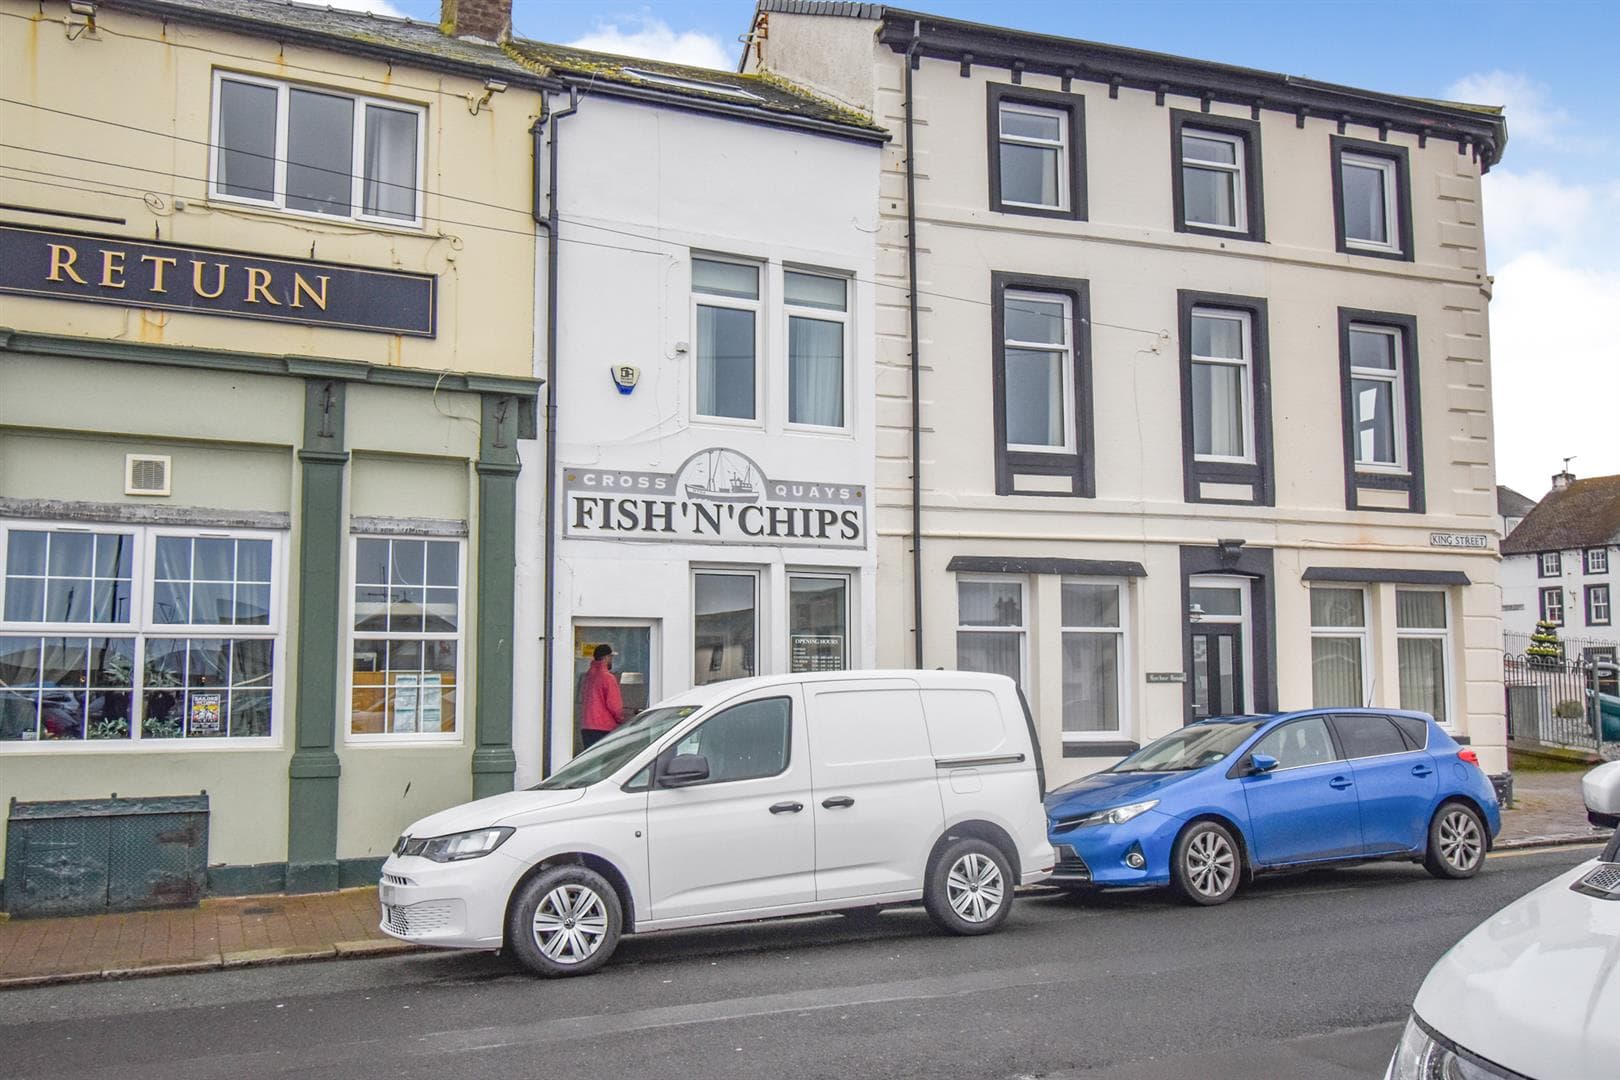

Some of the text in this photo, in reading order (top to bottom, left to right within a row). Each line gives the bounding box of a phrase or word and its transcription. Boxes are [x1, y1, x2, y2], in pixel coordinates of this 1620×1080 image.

[45, 243, 331, 311] RETURN
[583, 473, 851, 499] CROSS QUAYS
[572, 496, 861, 541] FISH'N'CHIPS
[1432, 535, 1485, 546] KING STREET
